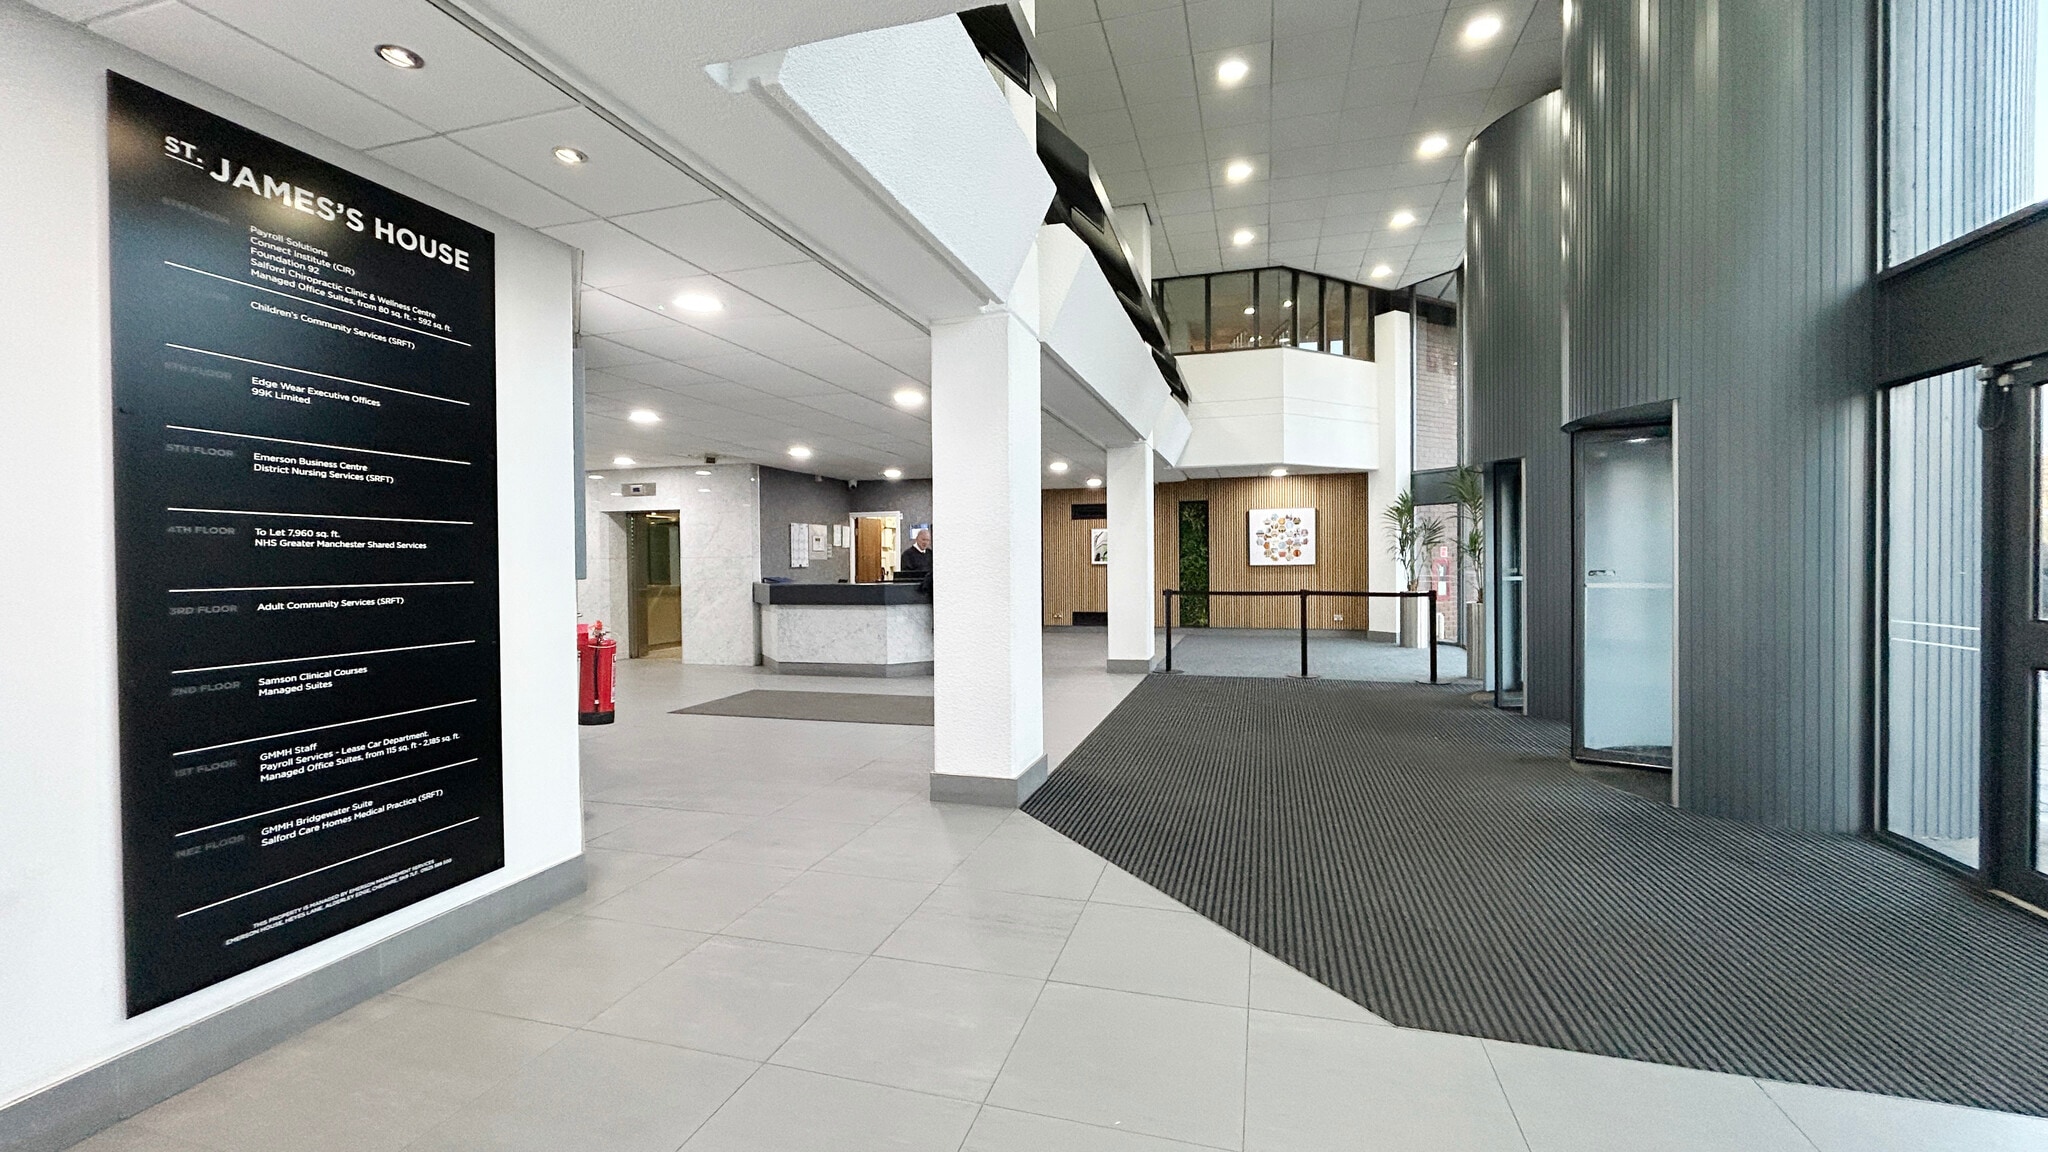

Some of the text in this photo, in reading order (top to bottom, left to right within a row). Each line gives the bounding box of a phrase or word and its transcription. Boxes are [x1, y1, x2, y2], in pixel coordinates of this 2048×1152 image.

[164, 135, 202, 163] ST.
[209, 158, 469, 271] JAMES'S HOUSE
[250, 225, 328, 257] Payroll Solutions
[250, 236, 354, 276] Connect Institute (CIR)
[250, 246, 319, 274] Foundation 92
[250, 257, 285, 274] Salford
[288, 269, 342, 291] Chiropractic
[344, 286, 367, 298] Clinic
[377, 295, 410, 311] Wellness
[412, 306, 436, 318] Centre
[250, 268, 295, 288] Managed
[298, 282, 325, 296] Office
[357, 299, 376, 310] from
[378, 305, 389, 314] 80
[418, 316, 430, 326] 592
[250, 301, 415, 349] Children's Community Services (SRFT)
[251, 376, 380, 406] Edge Wear Executive Offices
[251, 387, 310, 404] 99K Limited
[193, 446, 234, 456] FLOOR
[253, 452, 368, 471] Emerson Business Centre
[253, 463, 394, 484] District Nursing Services (SRFT)
[194, 526, 235, 534] FLOOR
[254, 527, 266, 536] To
[269, 528, 285, 536] Let
[254, 538, 277, 546] NHS
[279, 539, 315, 547] Greater
[316, 540, 365, 548] Manchester
[197, 604, 237, 613] FLOOR
[256, 602, 284, 610] Adult
[286, 600, 339, 609] Community
[376, 596, 404, 605] (SRFT)
[200, 680, 240, 692] FLOOR
[258, 667, 368, 686] Samson Clinical Courses
[258, 681, 333, 696] Managed Suites
[260, 742, 317, 760] GMMH Staff
[260, 757, 293, 771] Payroll
[294, 751, 333, 764] Services
[340, 744, 365, 754] Lease
[367, 740, 381, 748] Car
[260, 765, 304, 782] Managed
[306, 761, 334, 772] Office
[365, 750, 384, 759] from
[386, 745, 396, 754] 115
[261, 800, 373, 835] GMMH Bridgewater Suite
[261, 789, 443, 846] Salford Care Homes Medical Practice (SRFT)
